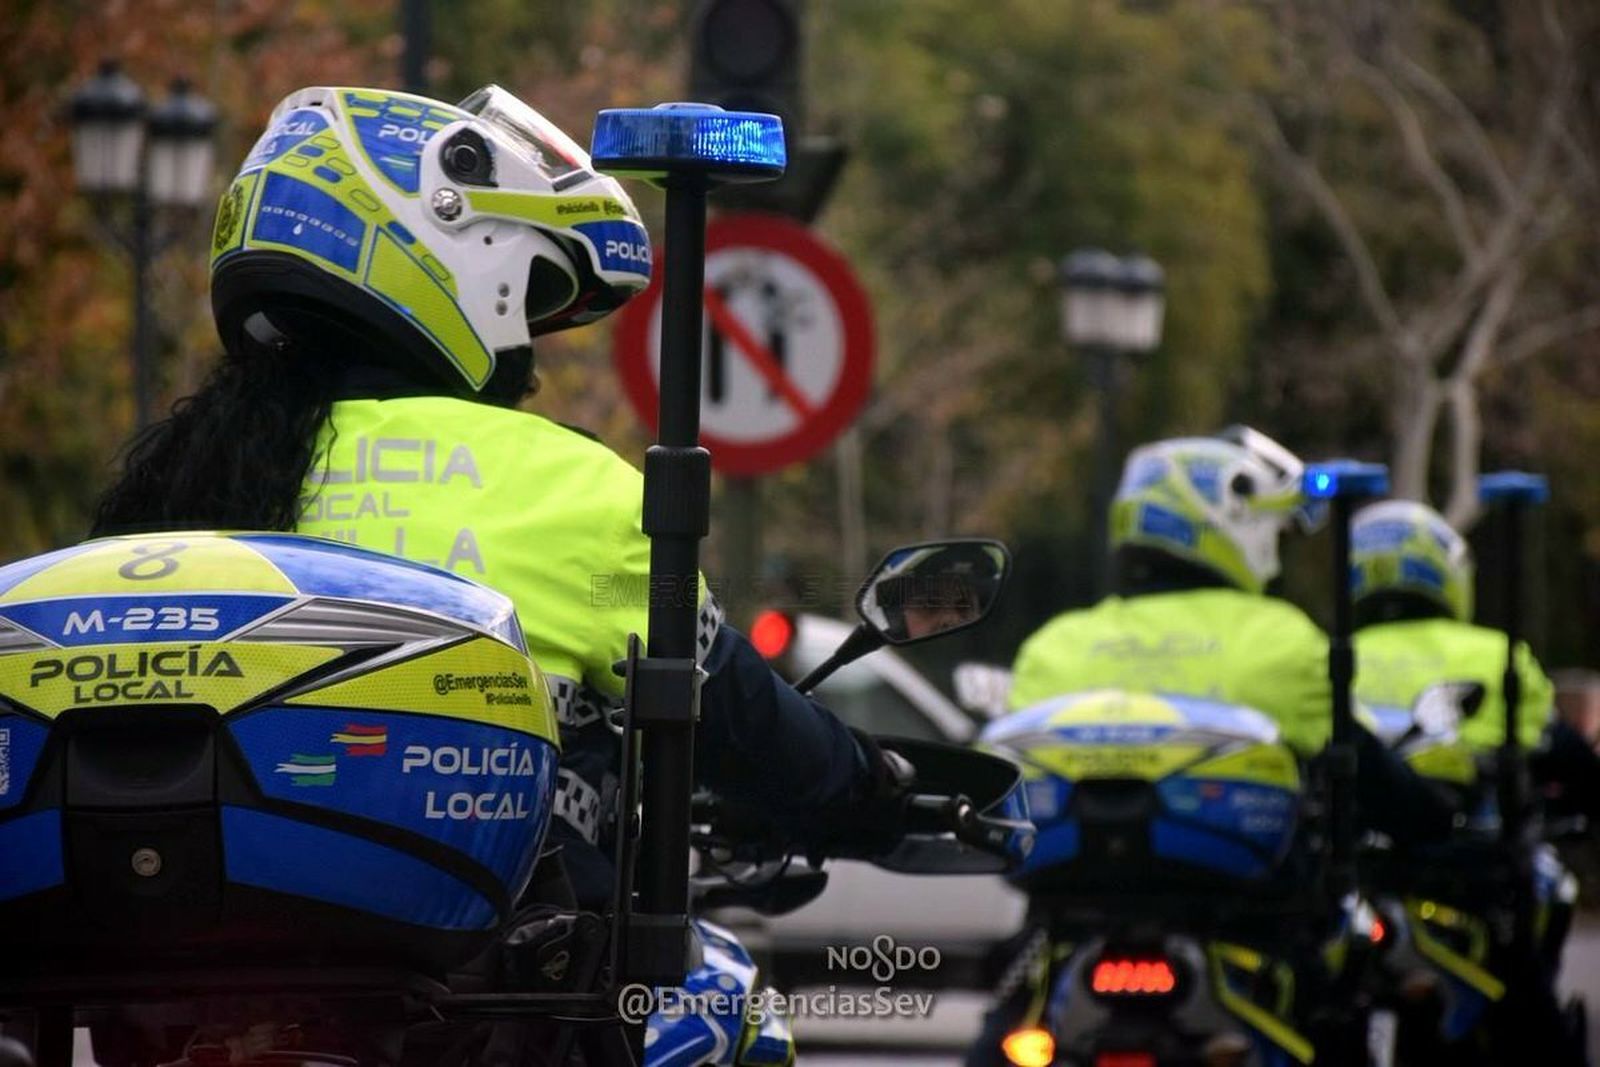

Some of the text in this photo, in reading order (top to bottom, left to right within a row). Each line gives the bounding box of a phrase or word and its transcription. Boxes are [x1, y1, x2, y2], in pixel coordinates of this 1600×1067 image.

[605, 240, 652, 264] POLIC
[308, 437, 484, 489] LICIA
[299, 491, 411, 523] OCAL
[62, 607, 220, 635] M-235
[30, 644, 244, 688] POLICÍA
[74, 679, 194, 704] LOCAL
[402, 742, 535, 776] POLICÍA
[425, 791, 529, 820] LOCAL
